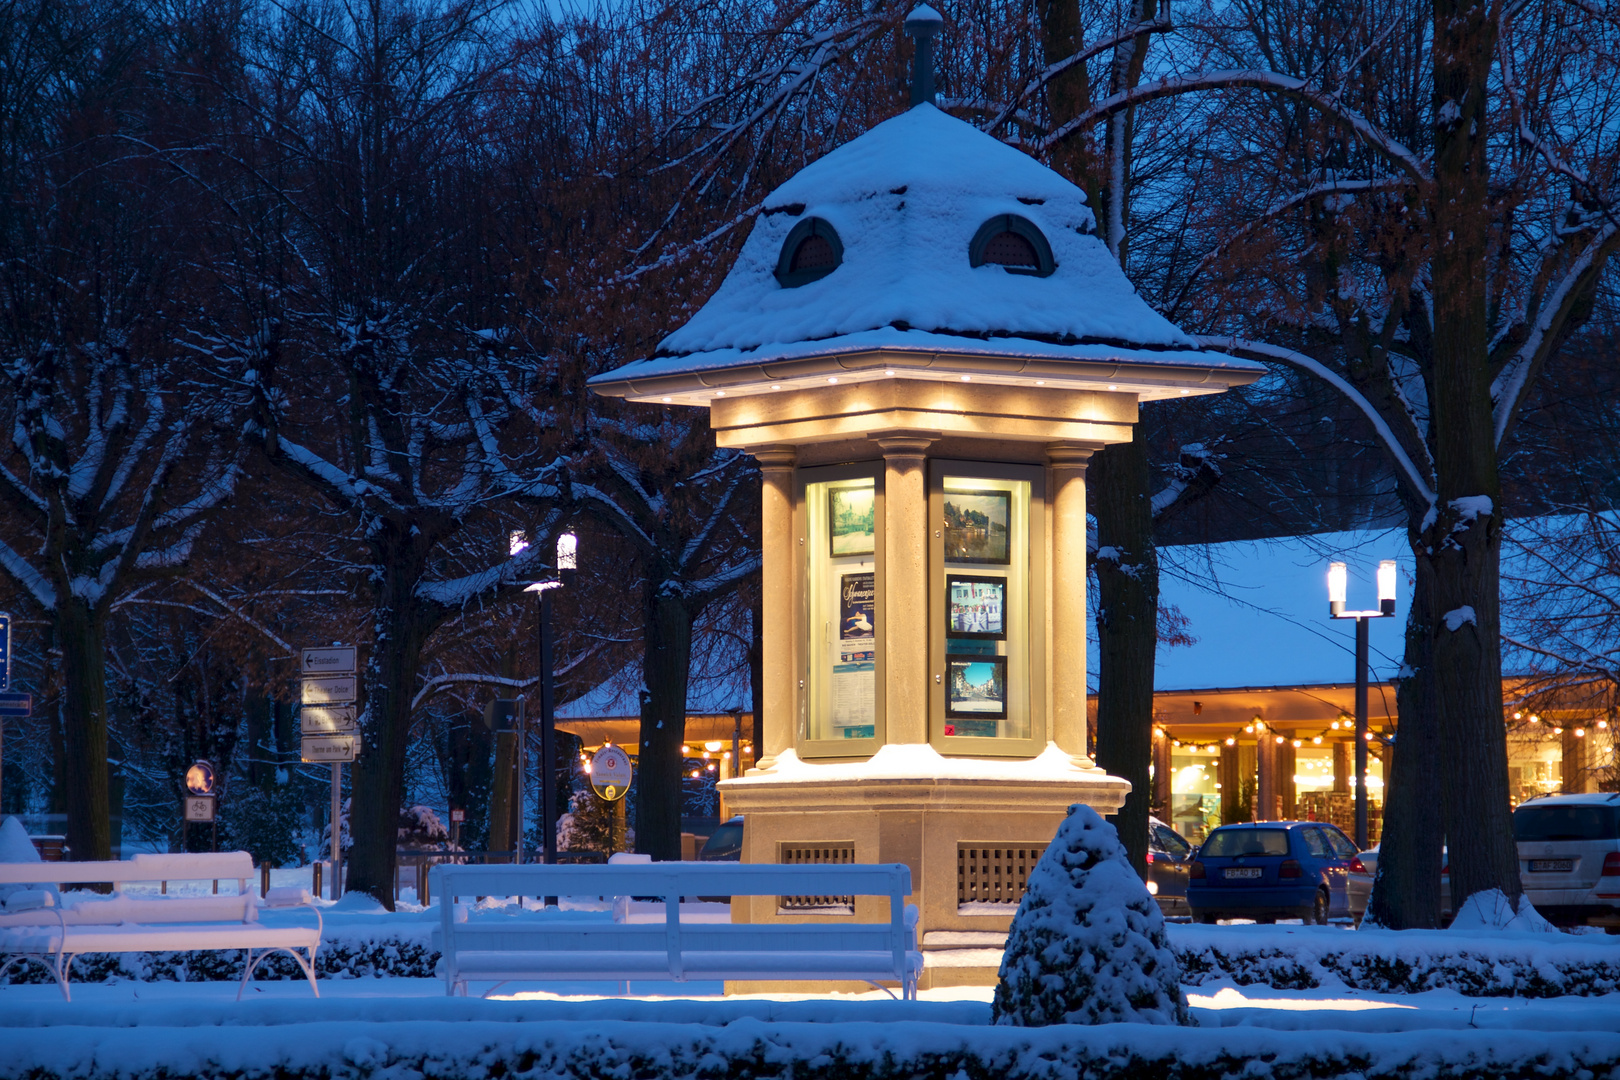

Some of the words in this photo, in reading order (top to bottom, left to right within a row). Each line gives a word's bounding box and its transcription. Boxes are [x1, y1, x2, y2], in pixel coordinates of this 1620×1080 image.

[314, 656, 340, 665] Eisstadion
[314, 686, 333, 694] Theater
[334, 685, 348, 693] Dolce
